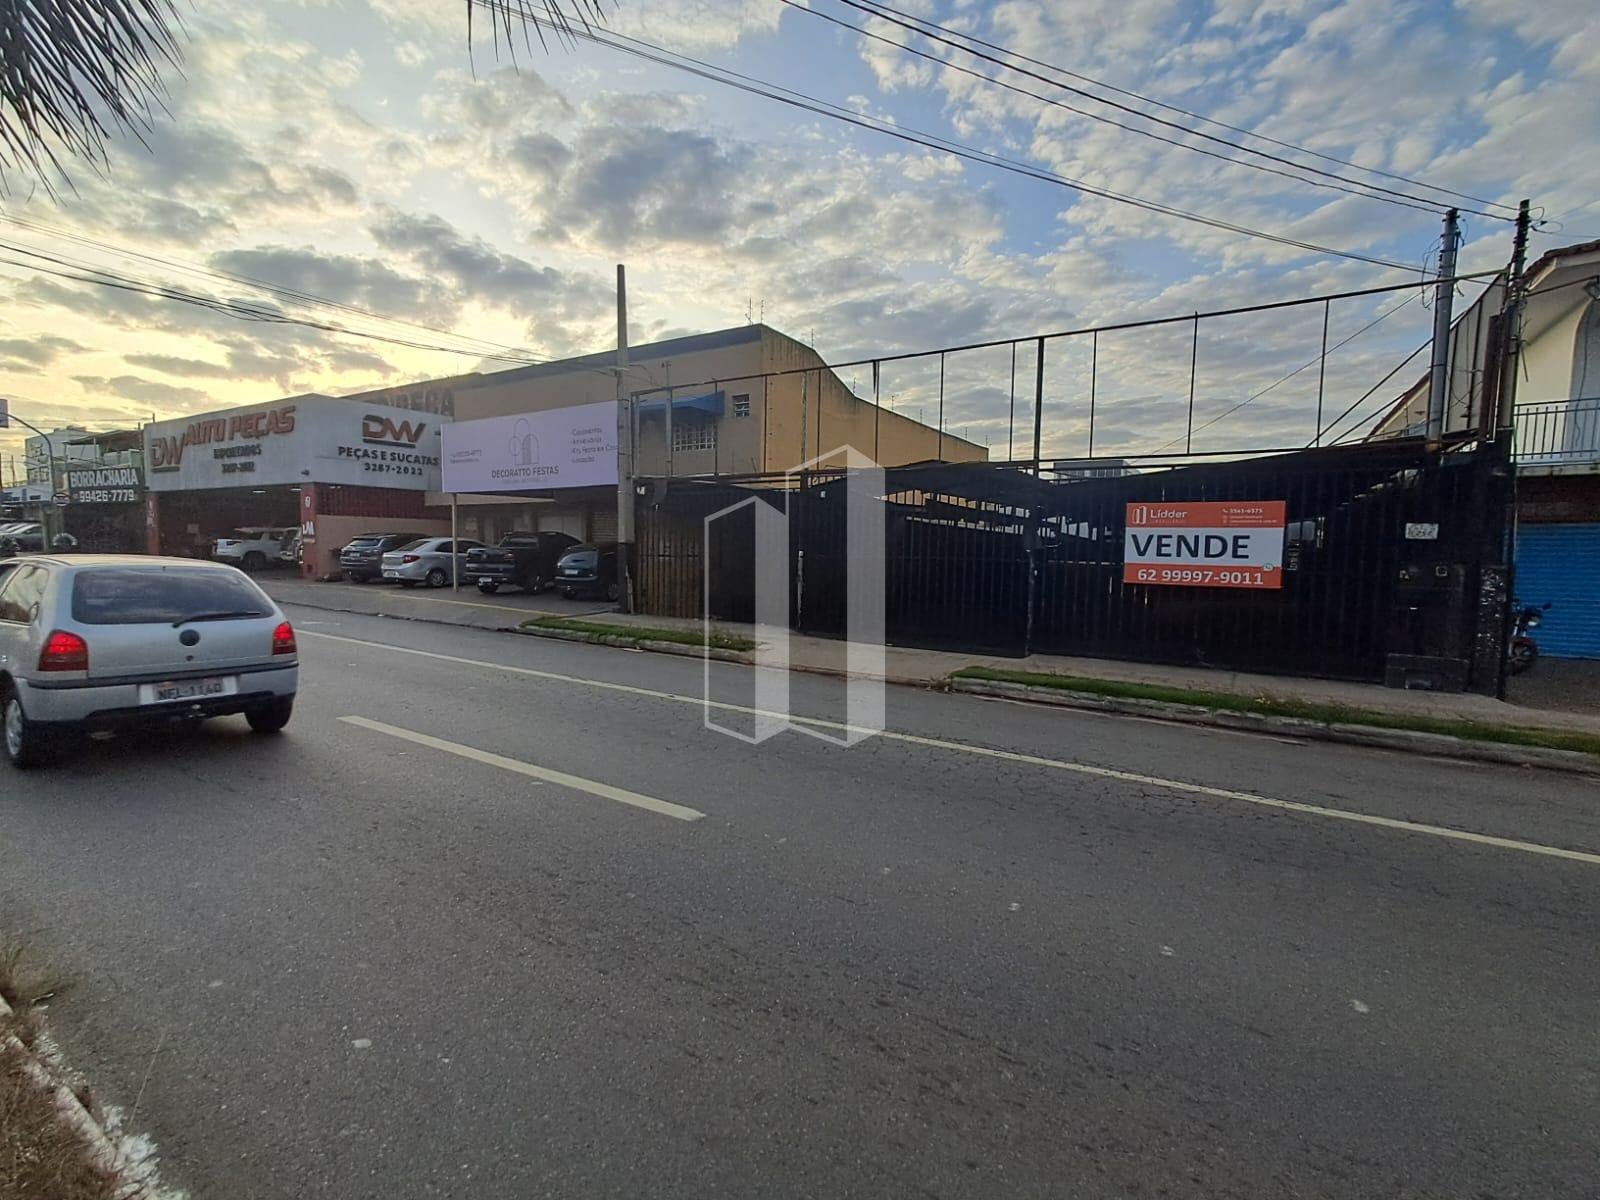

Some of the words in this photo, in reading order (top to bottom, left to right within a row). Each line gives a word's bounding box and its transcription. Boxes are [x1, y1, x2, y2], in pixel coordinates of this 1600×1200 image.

[185, 418, 226, 446] AUTO
[228, 407, 296, 440] PEÇAS
[362, 414, 427, 442] DW
[338, 446, 379, 460] PEÇAS
[380, 450, 388, 460] E
[390, 451, 440, 466] SUCATAS
[69, 468, 139, 488] BORRACHARIA
[491, 467, 532, 479] DECORATTO
[532, 465, 560, 476] FESTAS
[1131, 534, 1251, 559] VENDE
[1137, 568, 1157, 581] 62
[1161, 570, 1264, 585] 99997-9011
